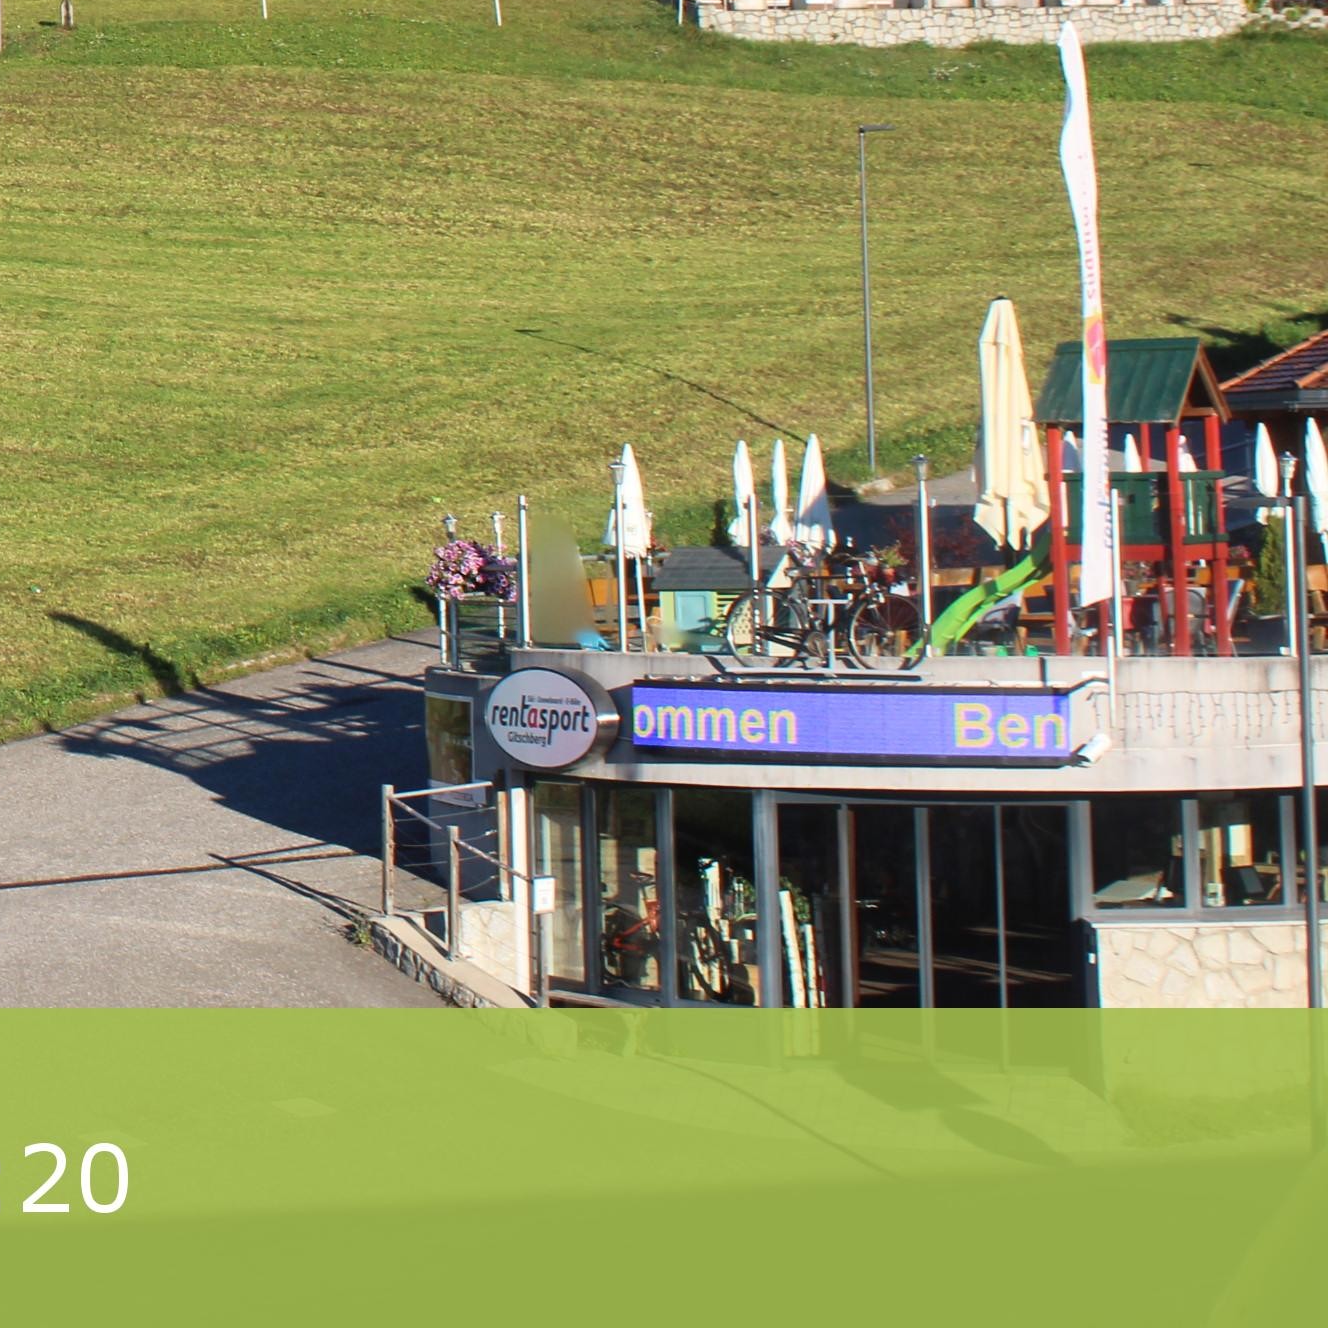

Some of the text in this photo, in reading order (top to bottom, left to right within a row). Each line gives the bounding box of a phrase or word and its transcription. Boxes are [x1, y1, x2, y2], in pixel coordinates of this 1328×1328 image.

[491, 695, 590, 745] rentasport
[507, 731, 547, 747] Gitschberg
[953, 701, 1066, 749] Ben
